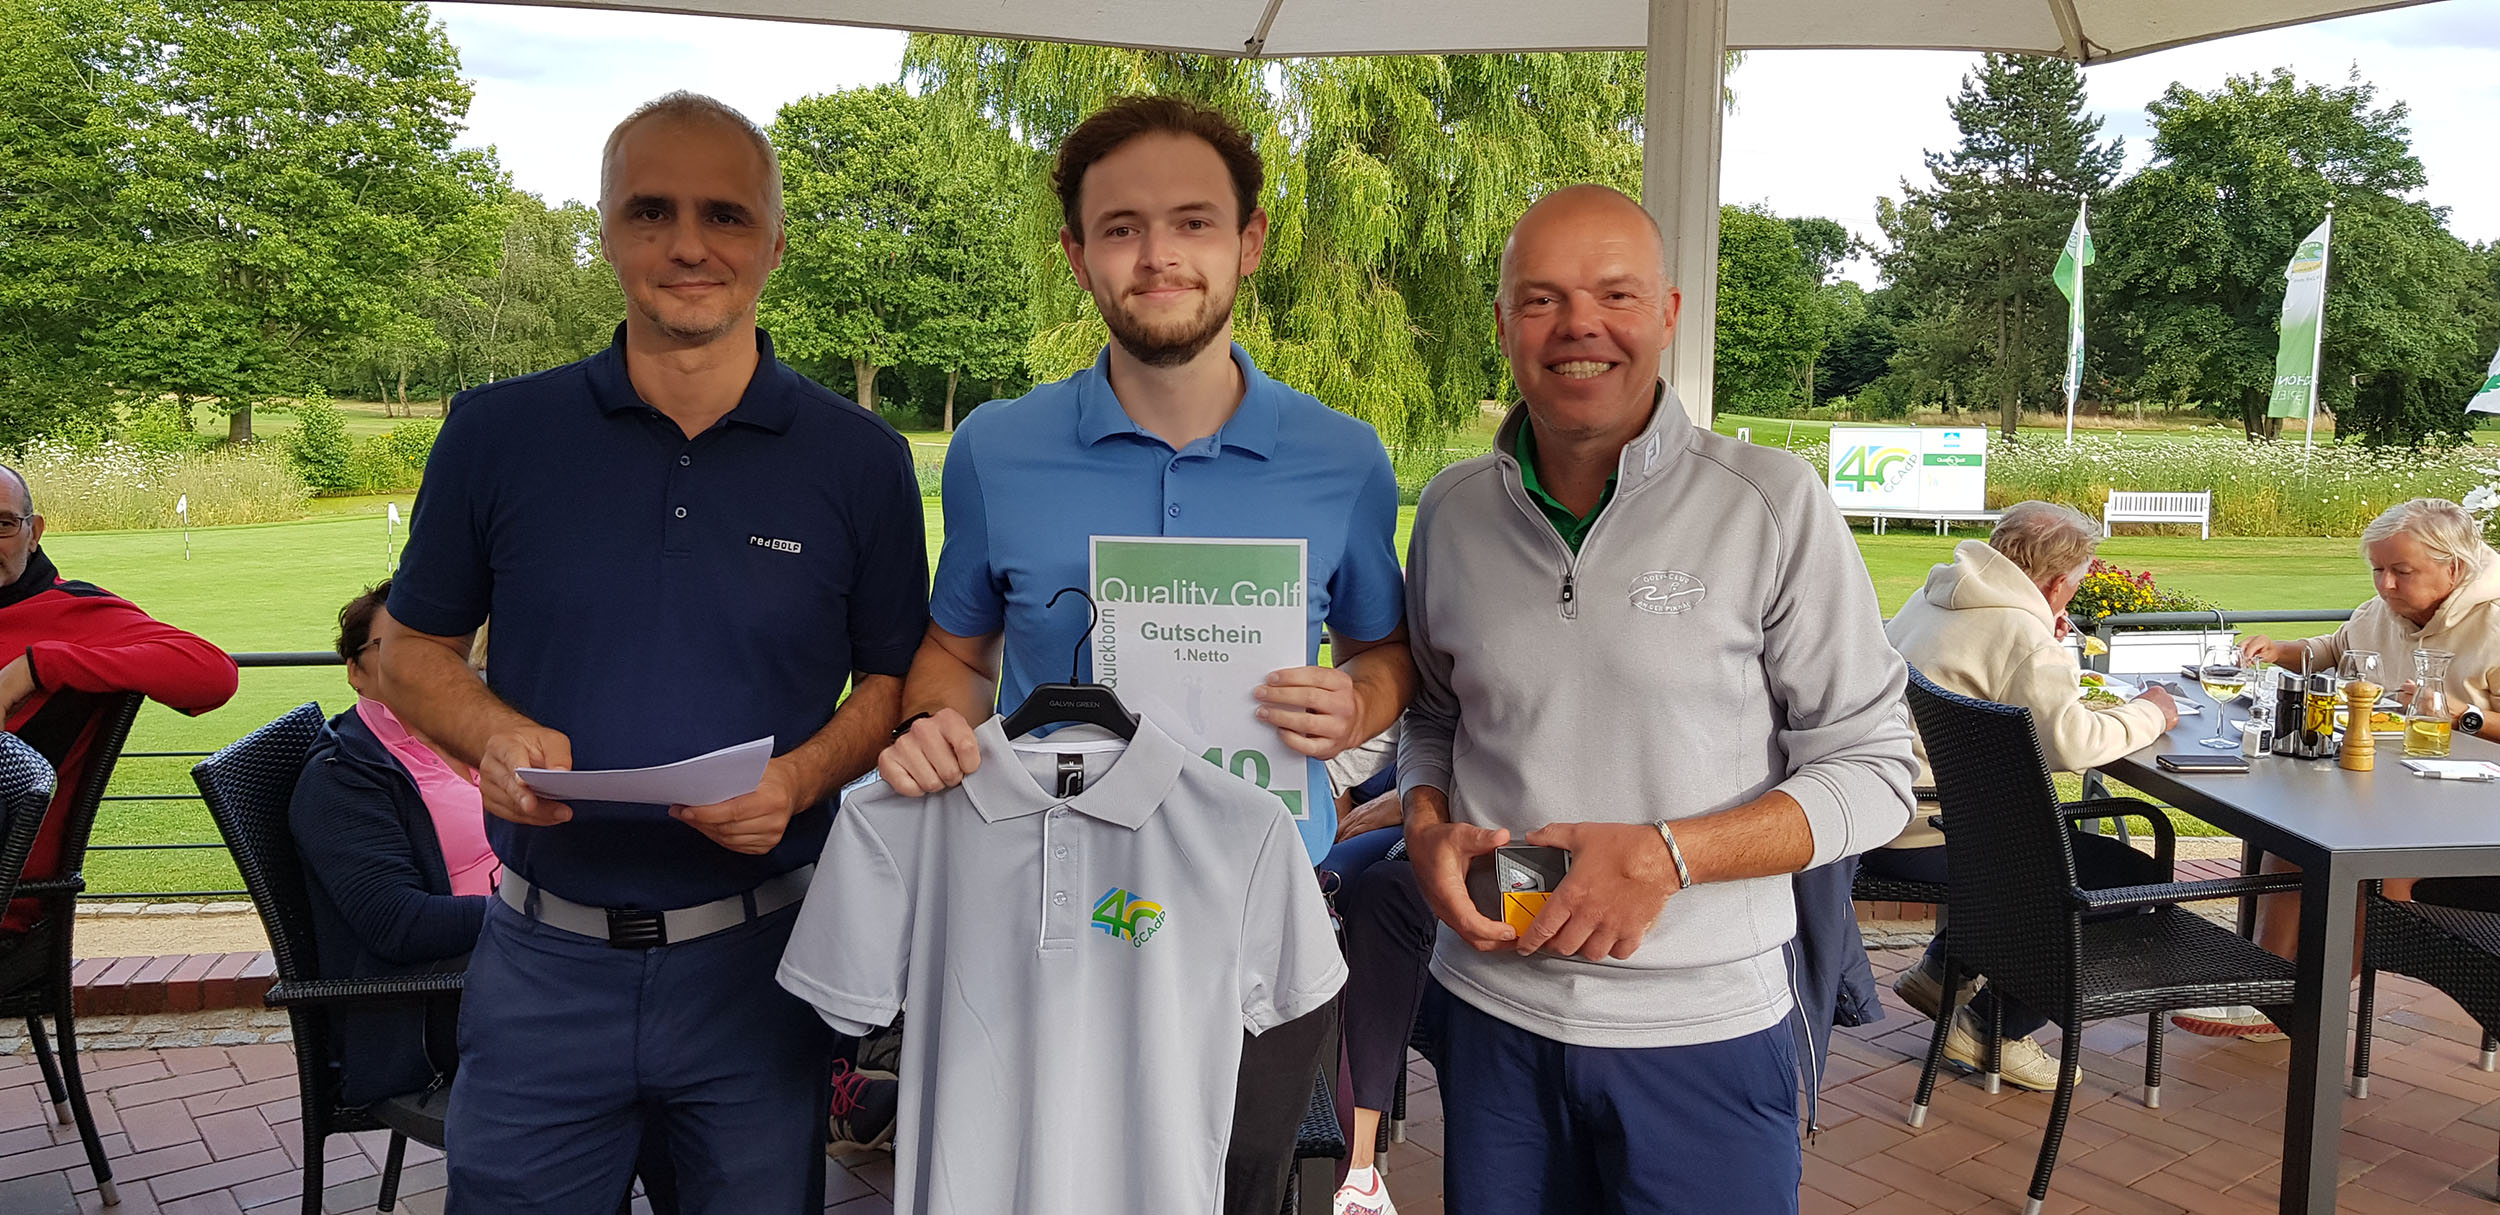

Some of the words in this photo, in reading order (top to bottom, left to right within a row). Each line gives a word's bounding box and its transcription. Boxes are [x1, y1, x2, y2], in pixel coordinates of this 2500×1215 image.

[1100, 577, 1219, 604] Quality
[1230, 580, 1302, 607] Golf
[1140, 621, 1262, 645] Gutschein
[1097, 608, 1118, 689] Quickborn
[1173, 648, 1229, 663] 1.Netto
[1049, 700, 1075, 708] GALVIN
[1076, 701, 1100, 709] GREEN
